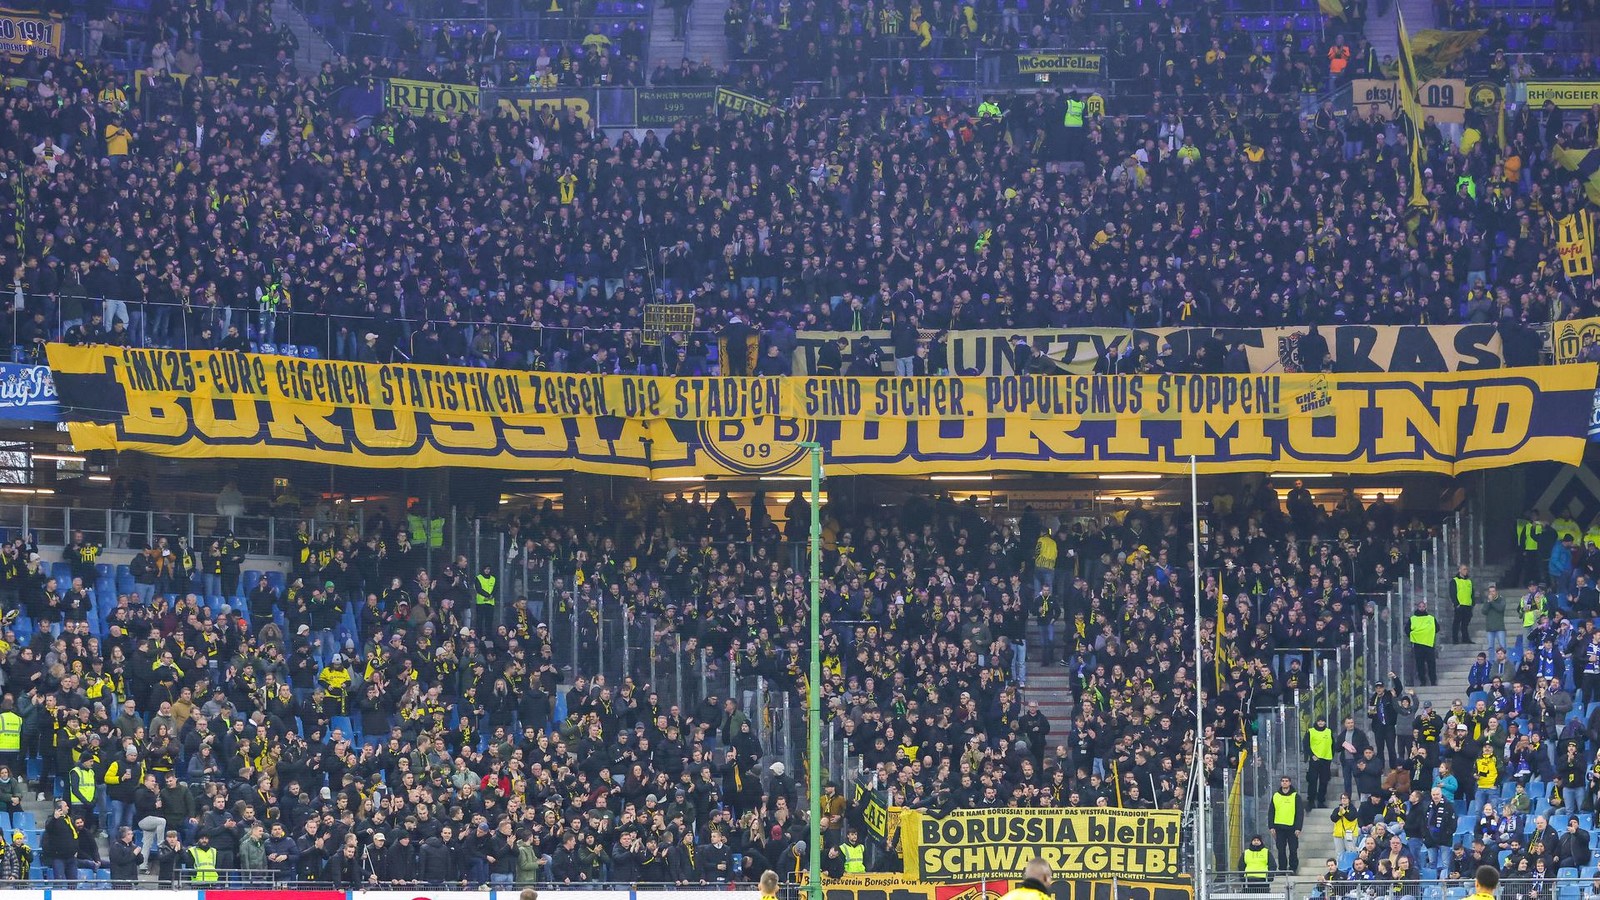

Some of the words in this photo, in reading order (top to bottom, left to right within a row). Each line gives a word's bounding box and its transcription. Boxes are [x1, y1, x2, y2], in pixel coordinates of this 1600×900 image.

[16, 21, 52, 44] 1991
[1030, 57, 1099, 70] GoodFellas
[392, 84, 478, 113] RHÖN
[1428, 85, 1454, 106] 09
[1528, 89, 1599, 100] RHÖNGEIER
[1089, 101, 1101, 113] 09
[742, 443, 771, 458] 09
[1080, 809, 1149, 817] WESTFALENSTADION!
[922, 816, 1078, 845] BORUSSIA
[1088, 816, 1178, 845] bleibt
[924, 846, 1178, 874] SCHWARZGELB!
[865, 876, 899, 888] Borussia
